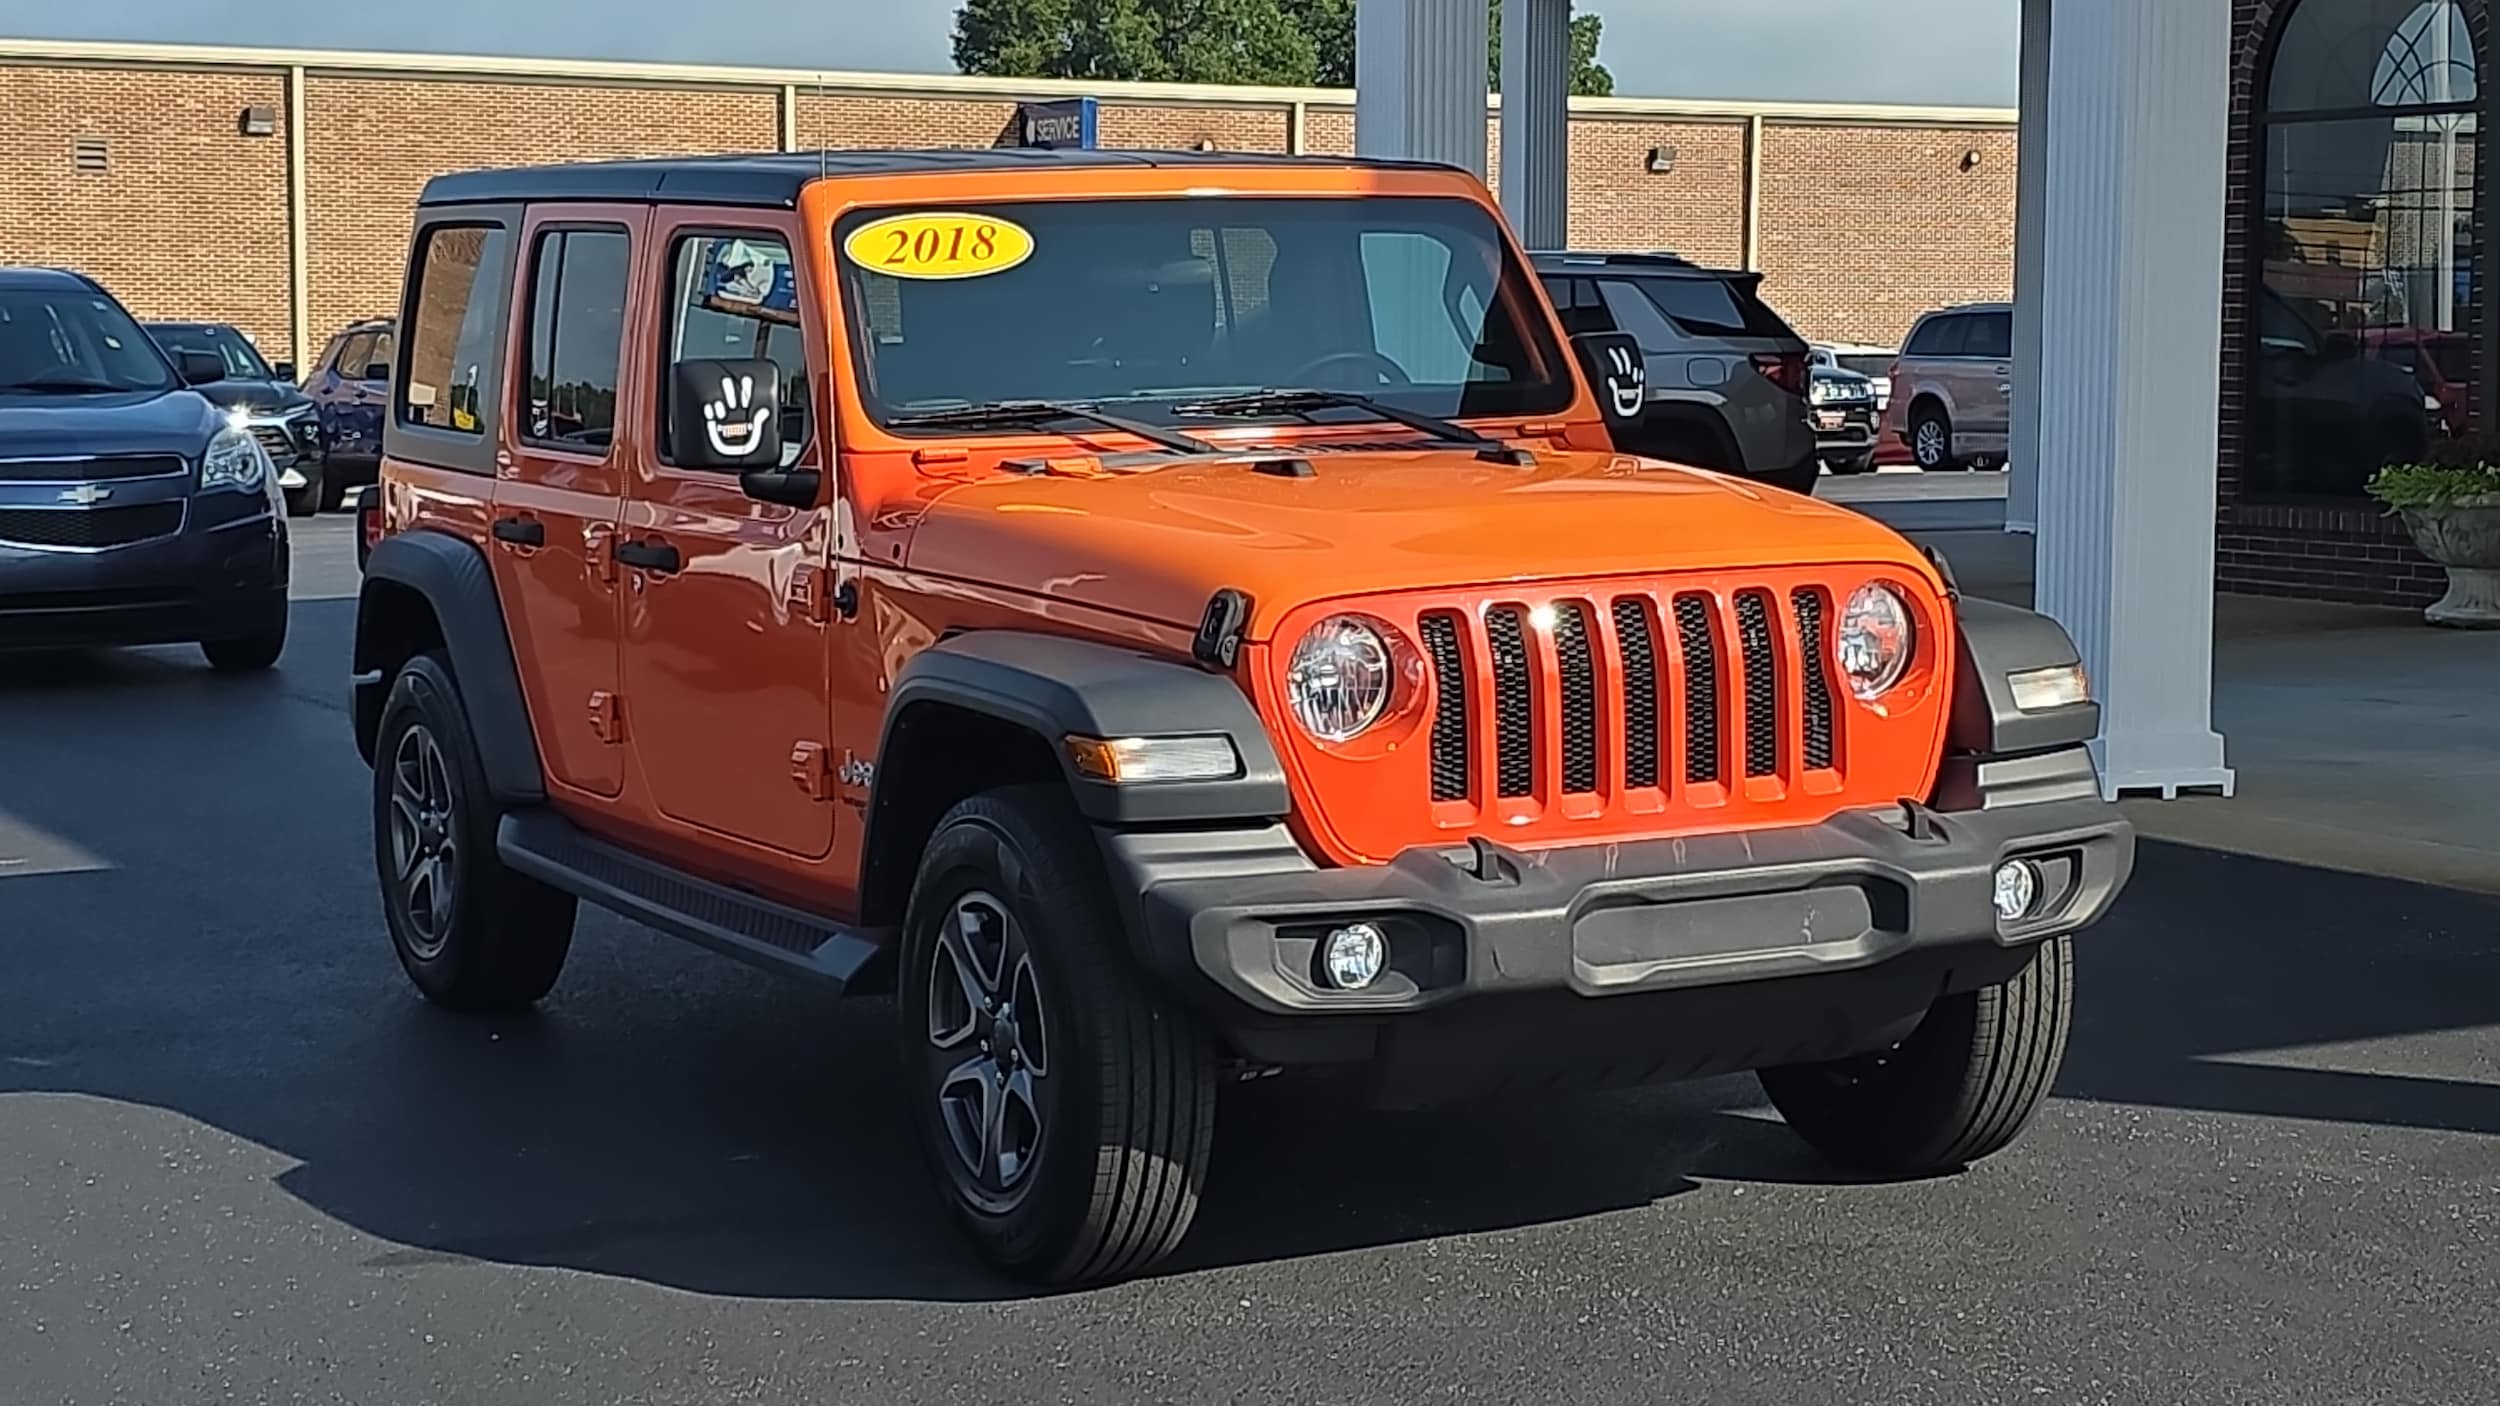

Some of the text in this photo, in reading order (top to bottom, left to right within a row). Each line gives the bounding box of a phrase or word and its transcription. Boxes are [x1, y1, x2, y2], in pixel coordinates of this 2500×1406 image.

[1037, 116, 1080, 141] SERVICE
[883, 225, 997, 265] 2018
[839, 748, 875, 787] Jee
